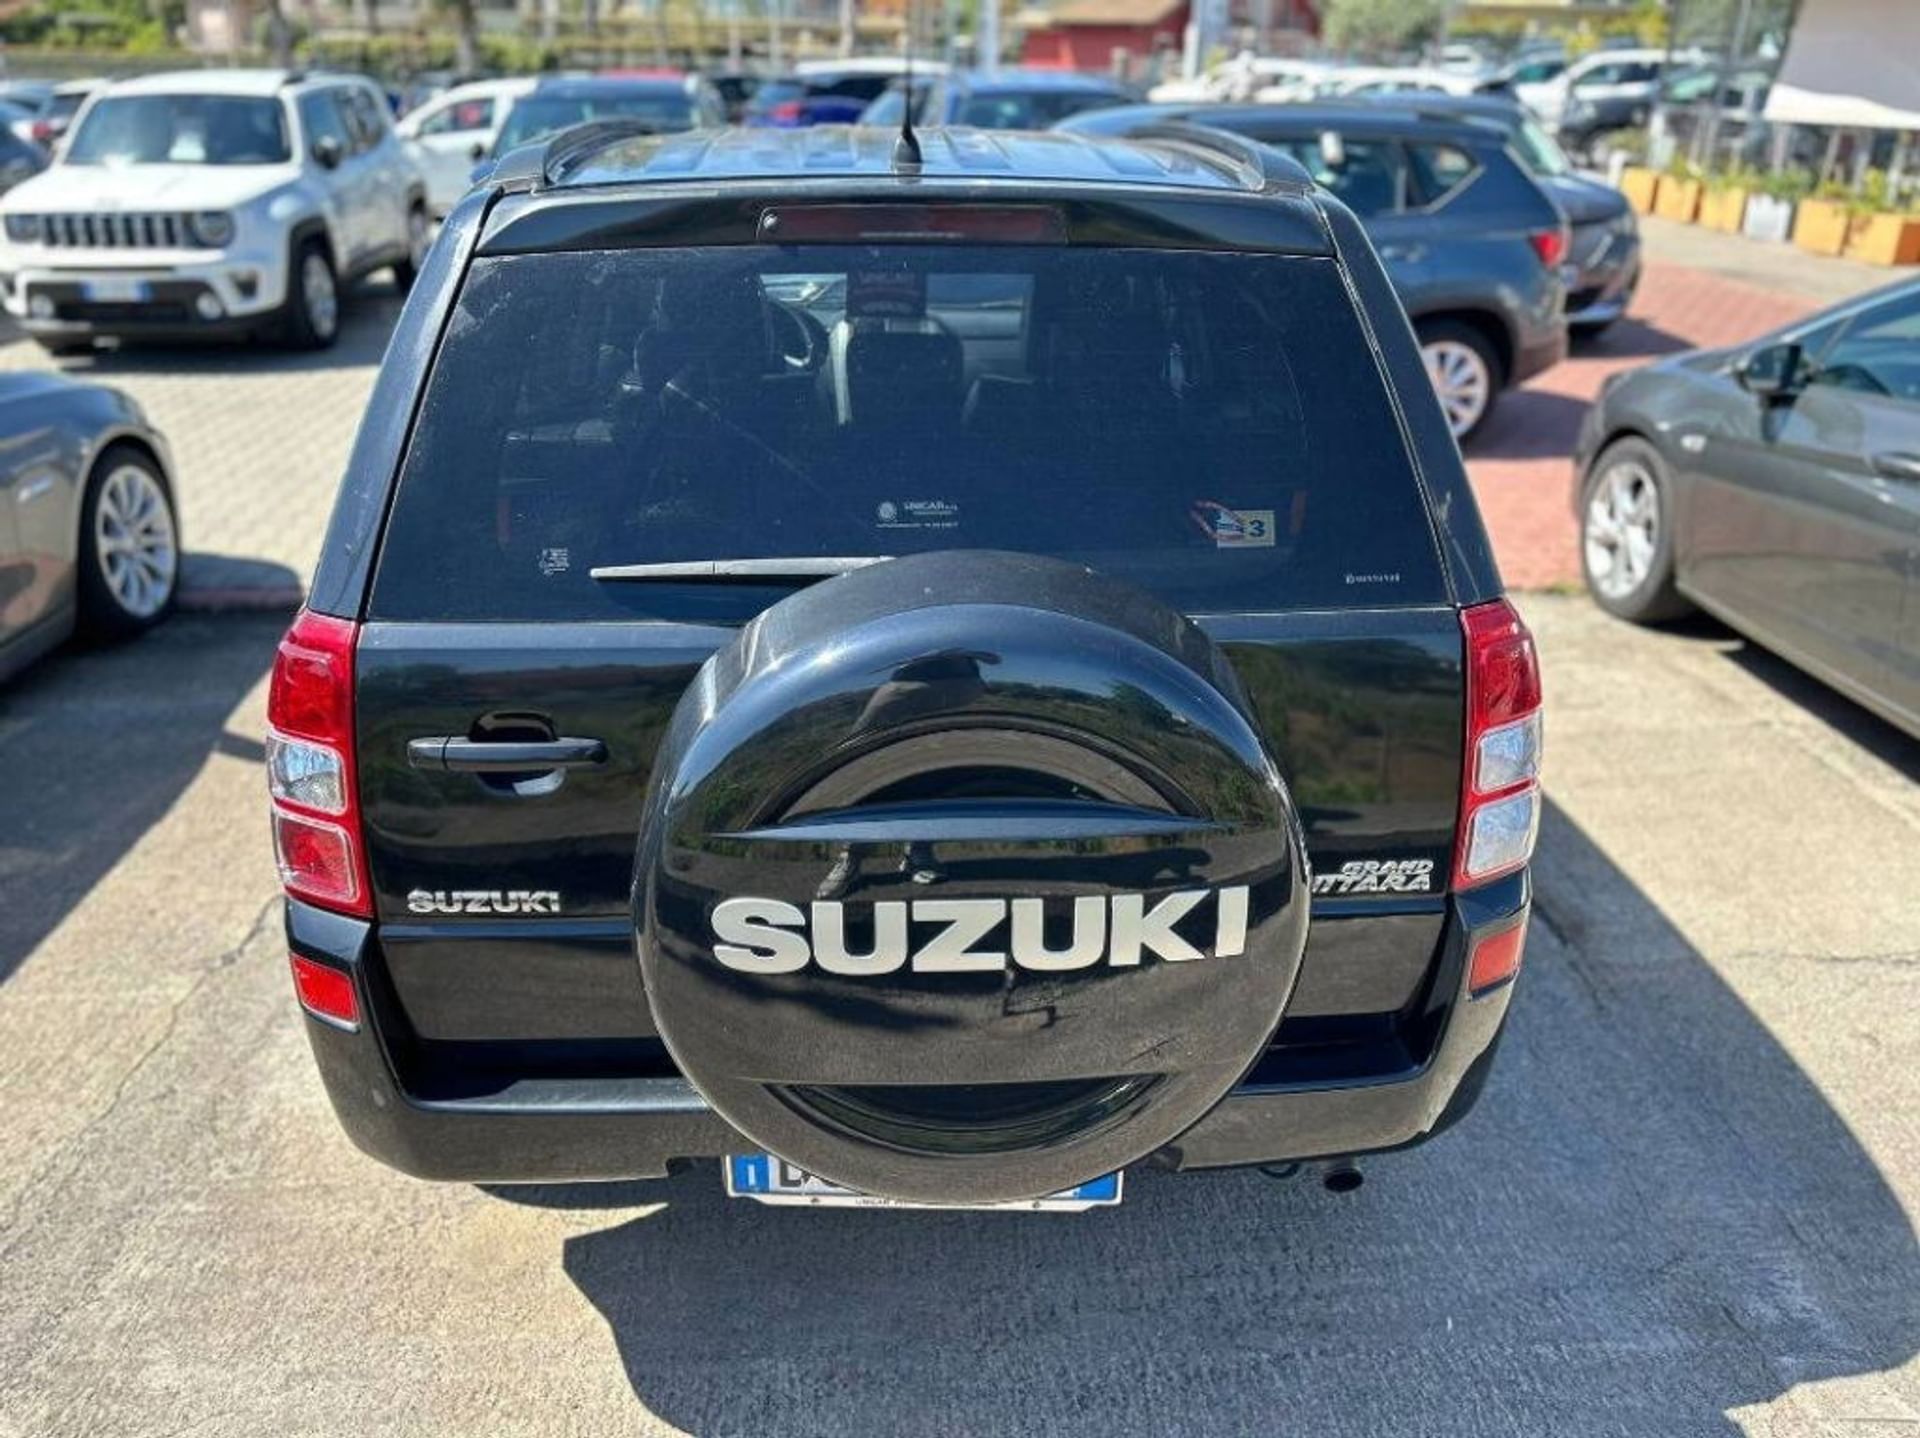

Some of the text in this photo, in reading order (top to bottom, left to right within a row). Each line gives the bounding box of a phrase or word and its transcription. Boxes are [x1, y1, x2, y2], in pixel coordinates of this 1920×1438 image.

[1249, 519, 1264, 537] 3
[1341, 860, 1434, 876] GRAND
[406, 889, 560, 913] SUZUKI
[710, 885, 1250, 975] SUZUKI
